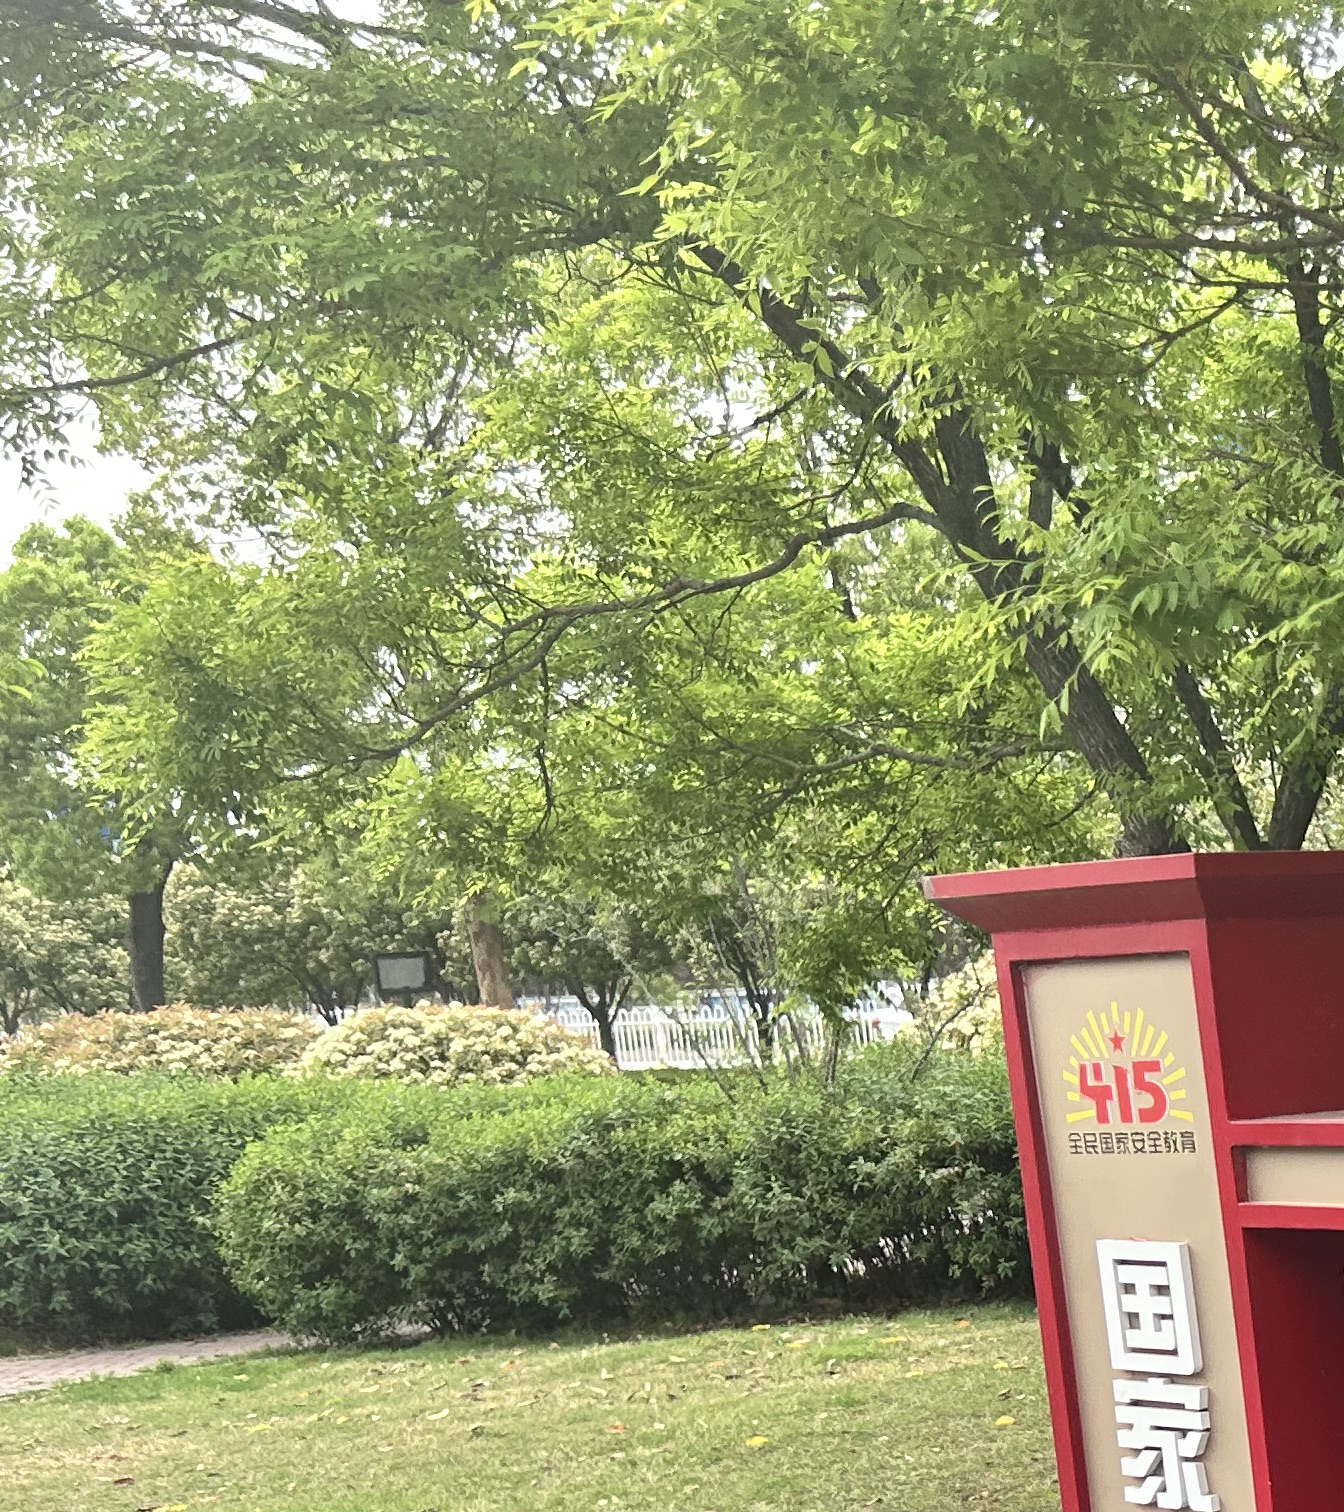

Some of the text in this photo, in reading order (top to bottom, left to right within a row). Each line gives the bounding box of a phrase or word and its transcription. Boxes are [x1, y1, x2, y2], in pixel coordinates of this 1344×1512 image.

[1078, 1060, 1169, 1125] 415
[1068, 1131, 1196, 1155] 全民国家安全教育
